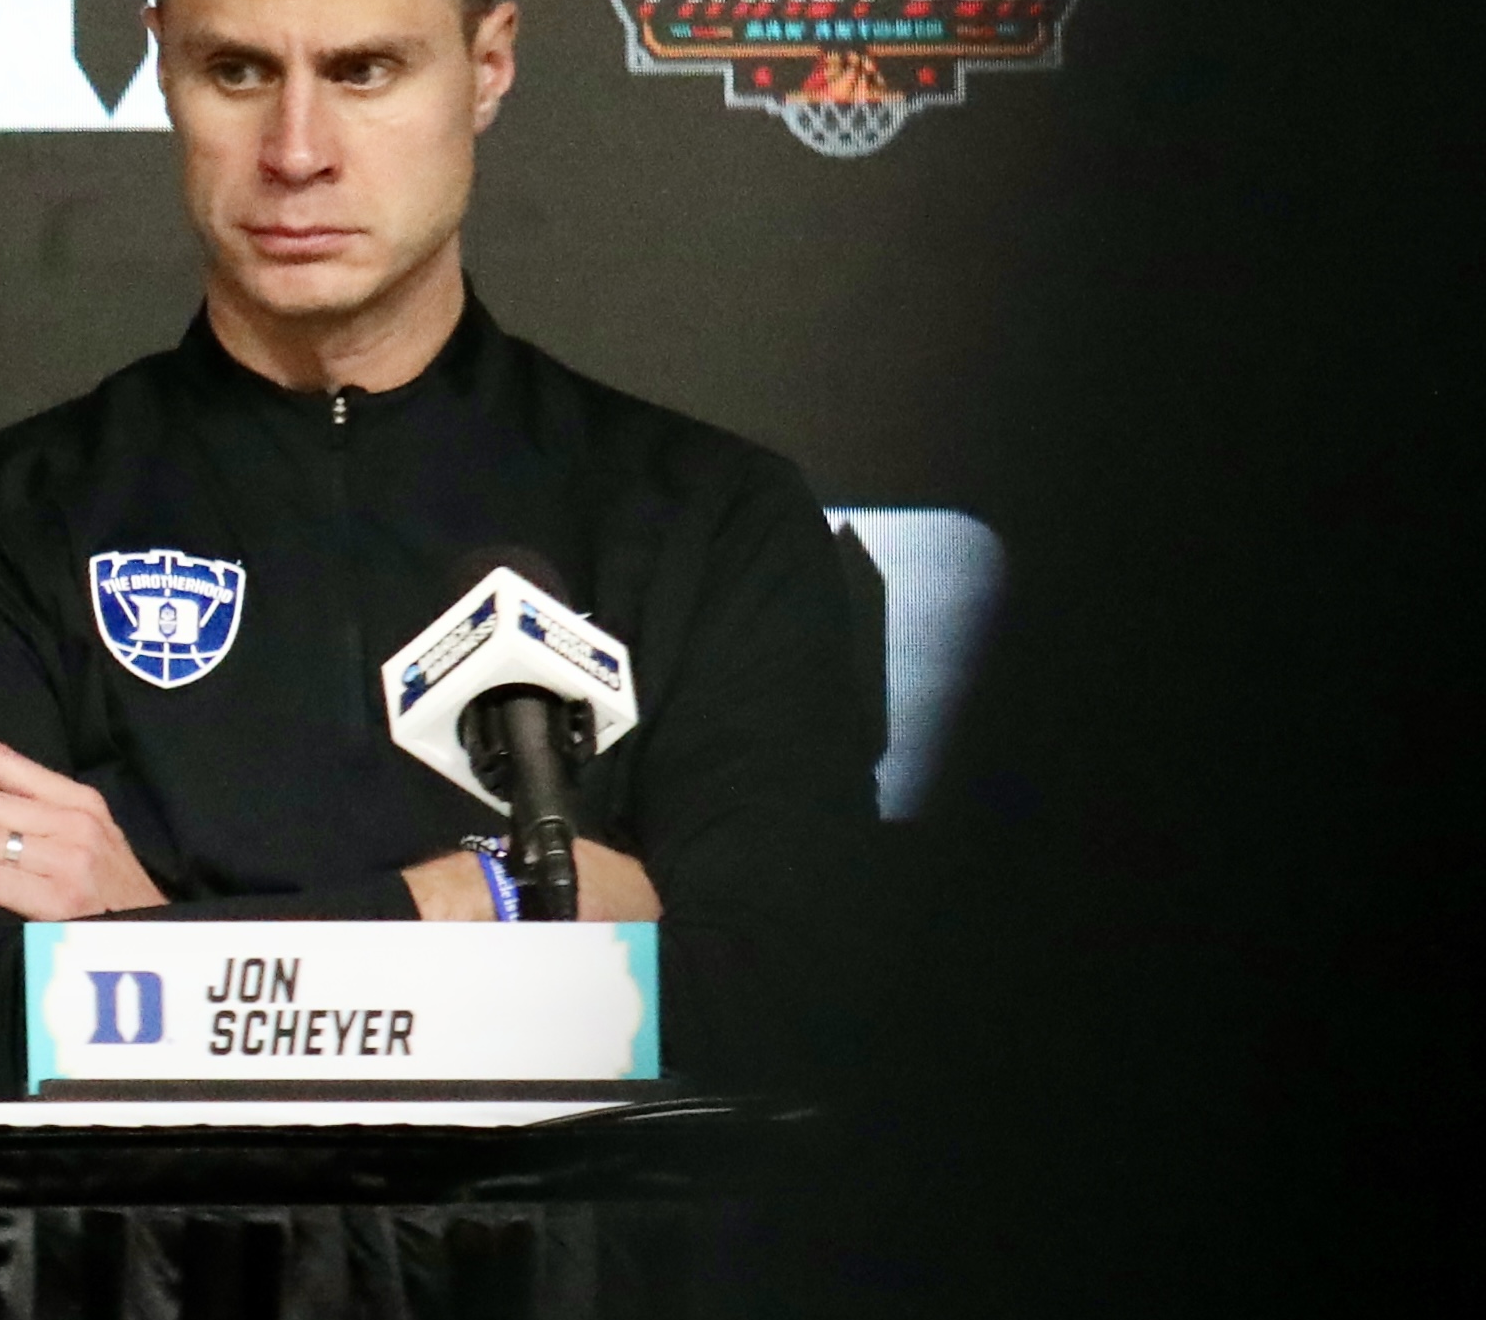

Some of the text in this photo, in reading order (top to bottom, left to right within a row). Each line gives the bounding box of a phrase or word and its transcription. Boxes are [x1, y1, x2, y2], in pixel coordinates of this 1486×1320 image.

[100, 573, 233, 605] THE BROTHERHOOD
[207, 957, 302, 1004] JON
[85, 970, 165, 1045] D
[209, 1009, 416, 1057] SCHEYER
